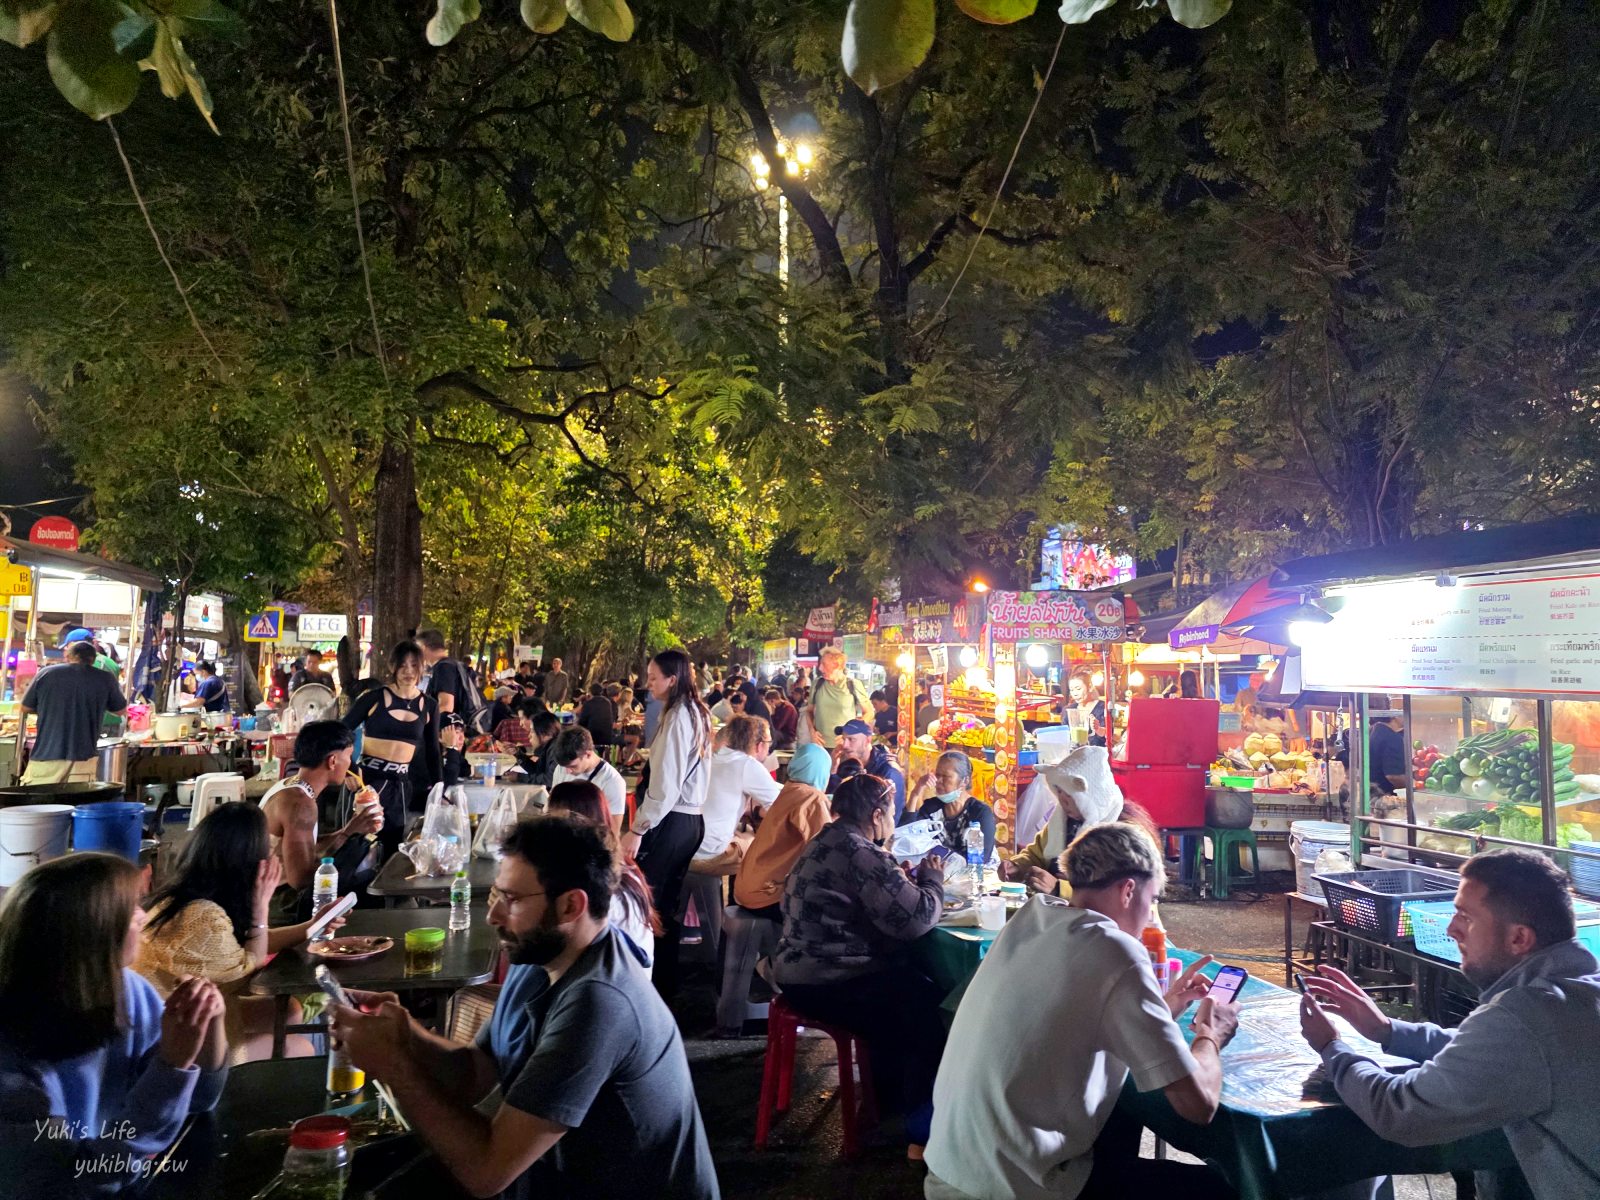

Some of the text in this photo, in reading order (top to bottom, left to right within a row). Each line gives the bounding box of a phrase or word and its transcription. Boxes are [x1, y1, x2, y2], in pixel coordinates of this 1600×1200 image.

[991, 592, 1087, 624] น้ำผลไม้ปั่น
[912, 619, 943, 640] 水果冰沙
[991, 626, 1072, 639] FRUITS SHAKE
[1075, 626, 1122, 640] 水果冰沙
